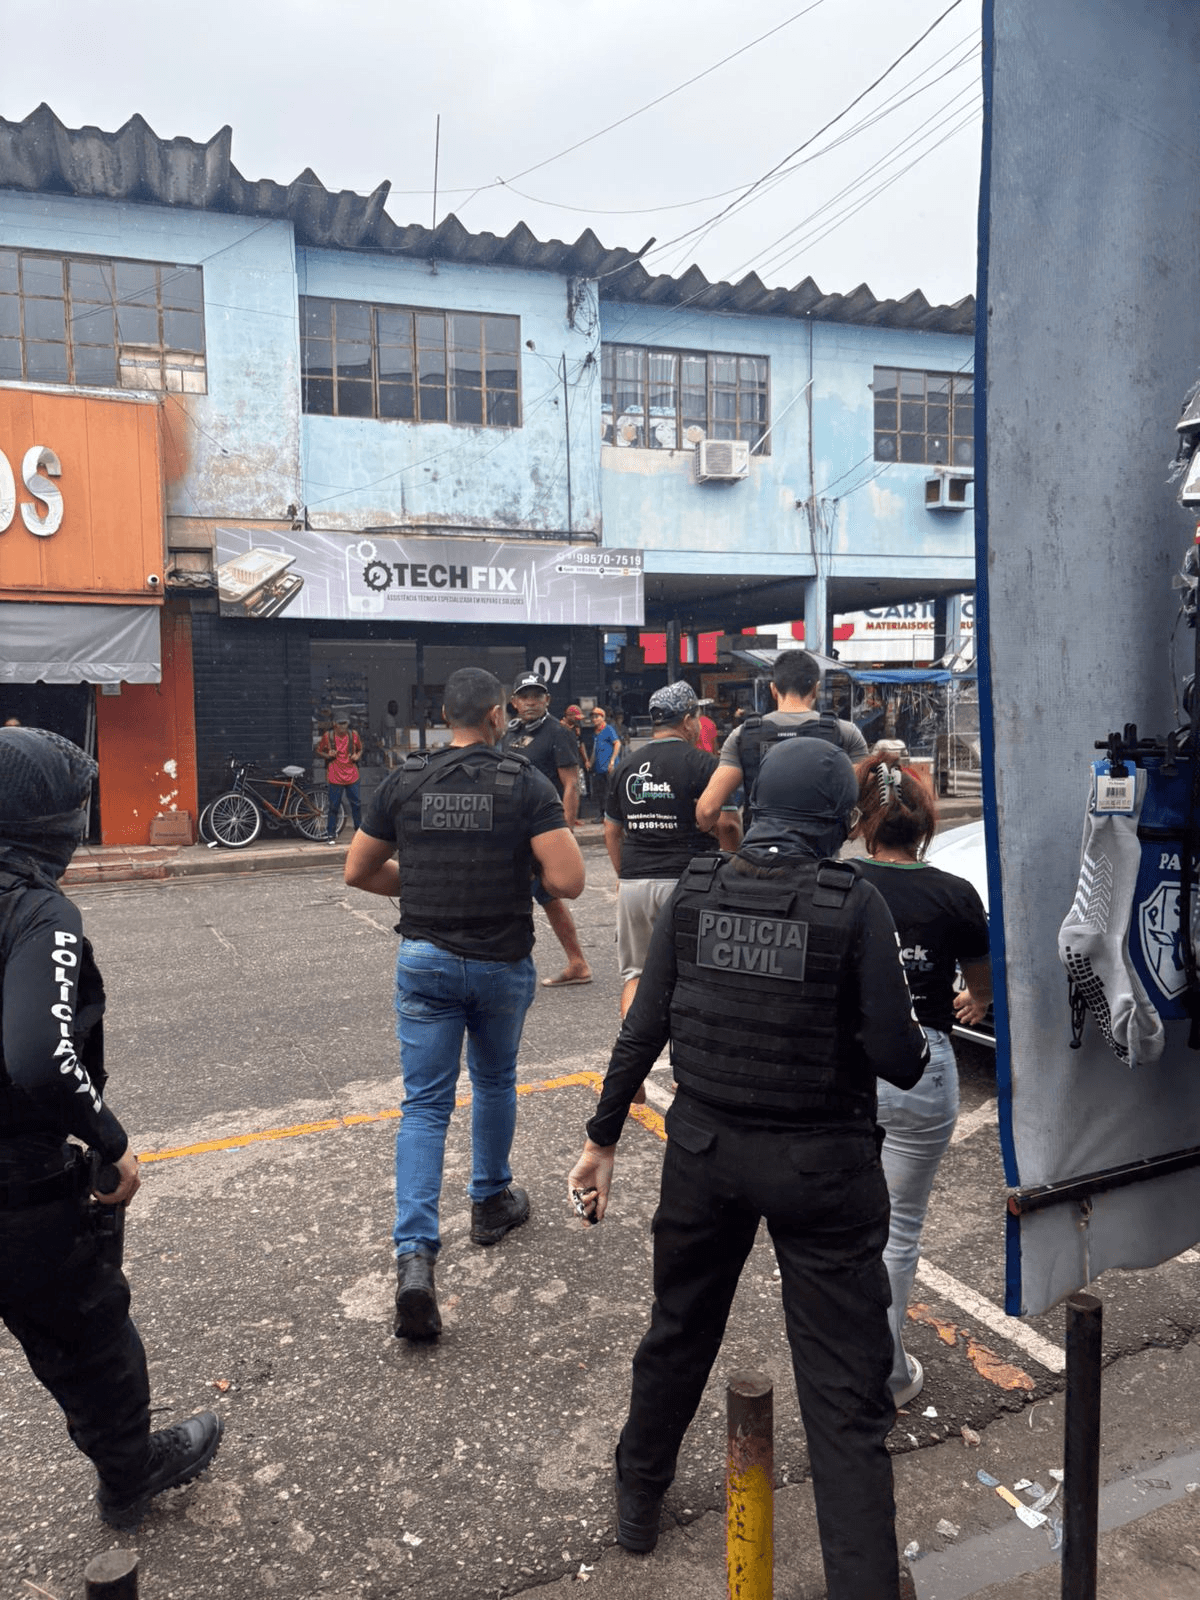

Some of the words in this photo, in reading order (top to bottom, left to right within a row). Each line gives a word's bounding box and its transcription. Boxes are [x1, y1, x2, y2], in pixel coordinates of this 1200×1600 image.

[576, 553, 641, 566] 98570-7519
[393, 563, 517, 591] TECHFIX
[533, 656, 567, 683] 07
[643, 782, 671, 792] Black
[432, 812, 479, 828] CIVIL
[712, 943, 783, 974] CIVIL
